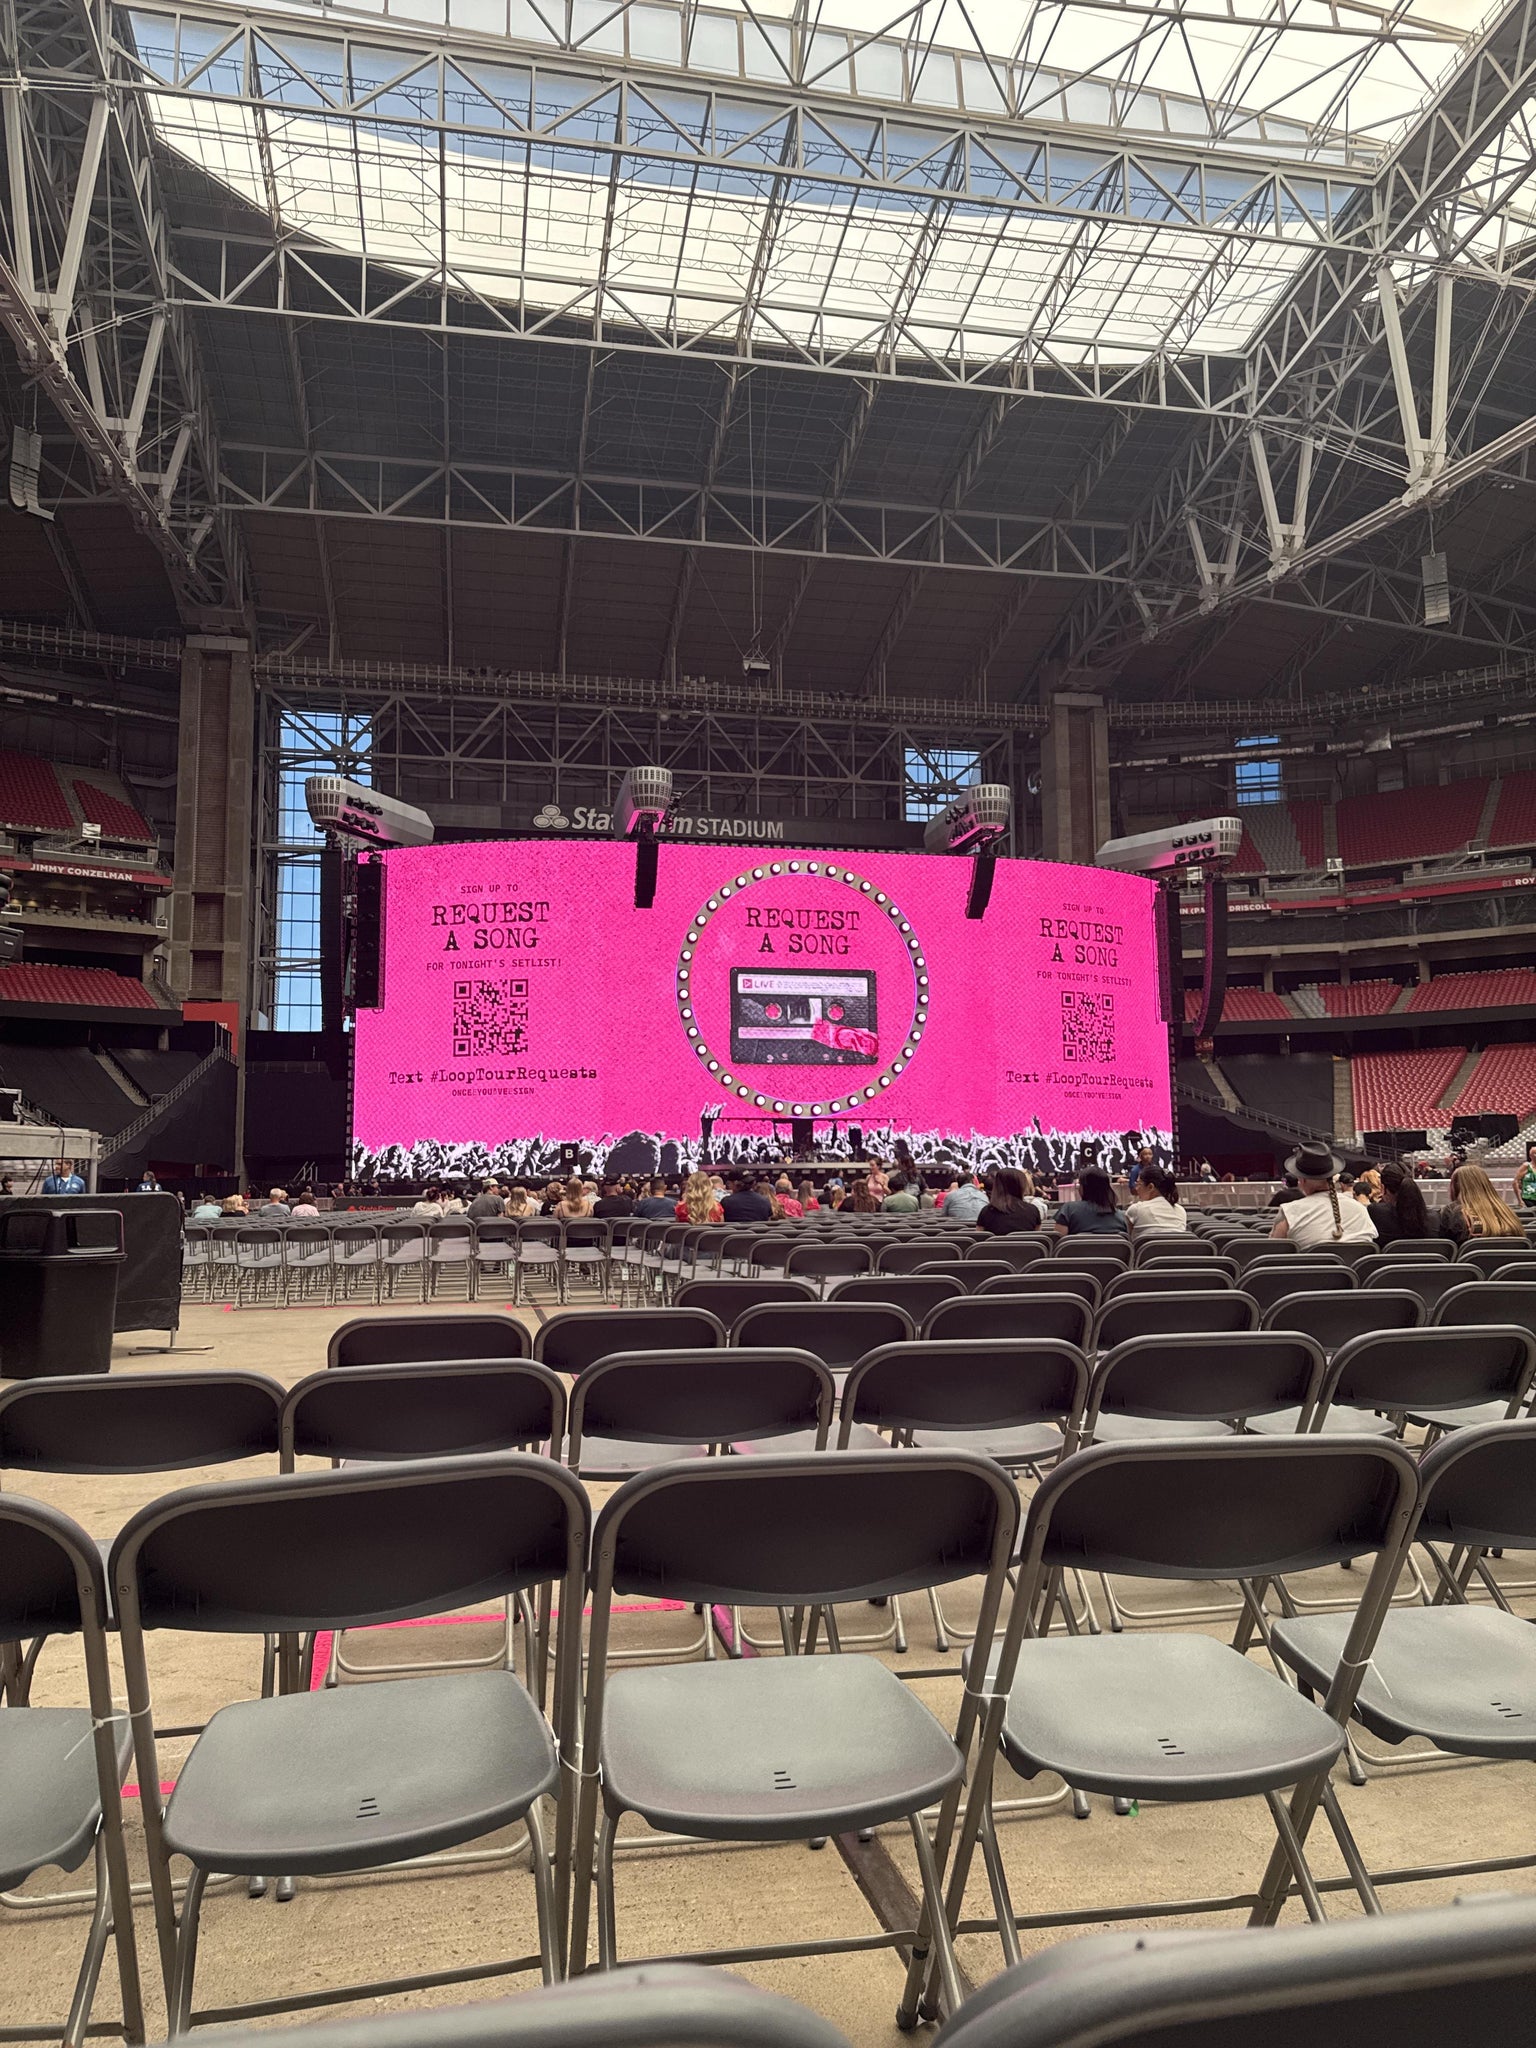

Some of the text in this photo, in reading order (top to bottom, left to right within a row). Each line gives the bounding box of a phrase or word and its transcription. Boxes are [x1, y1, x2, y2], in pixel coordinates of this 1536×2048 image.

[572, 806, 614, 830] Sta
[696, 818, 784, 838] STADIUM
[30, 863, 133, 880] JIMMY CONZELMAN
[460, 884, 518, 894] SIGN UP TO
[1515, 877, 1535, 886] ROY
[431, 902, 550, 926] REQUEST
[1062, 903, 1080, 911] SIGN
[1084, 905, 1092, 913] UP
[1229, 904, 1272, 912] DRISCOLL
[745, 907, 860, 930] REQUEST
[443, 927, 540, 950] A SONG
[1039, 918, 1124, 945] REQUEST
[758, 933, 851, 954] A SONG
[1051, 943, 1119, 967] A SONG
[426, 958, 562, 971] FOR TONIGHT'S SETLIST!
[754, 980, 775, 988] LIVE
[1037, 971, 1132, 986] FOR TONIGHT'S SETLIST!
[389, 1066, 598, 1084] Text #LoopTourRequests
[1006, 1070, 1154, 1089] Text #LoopTourRequests
[565, 1149, 574, 1159] B
[1084, 1147, 1093, 1157] C
